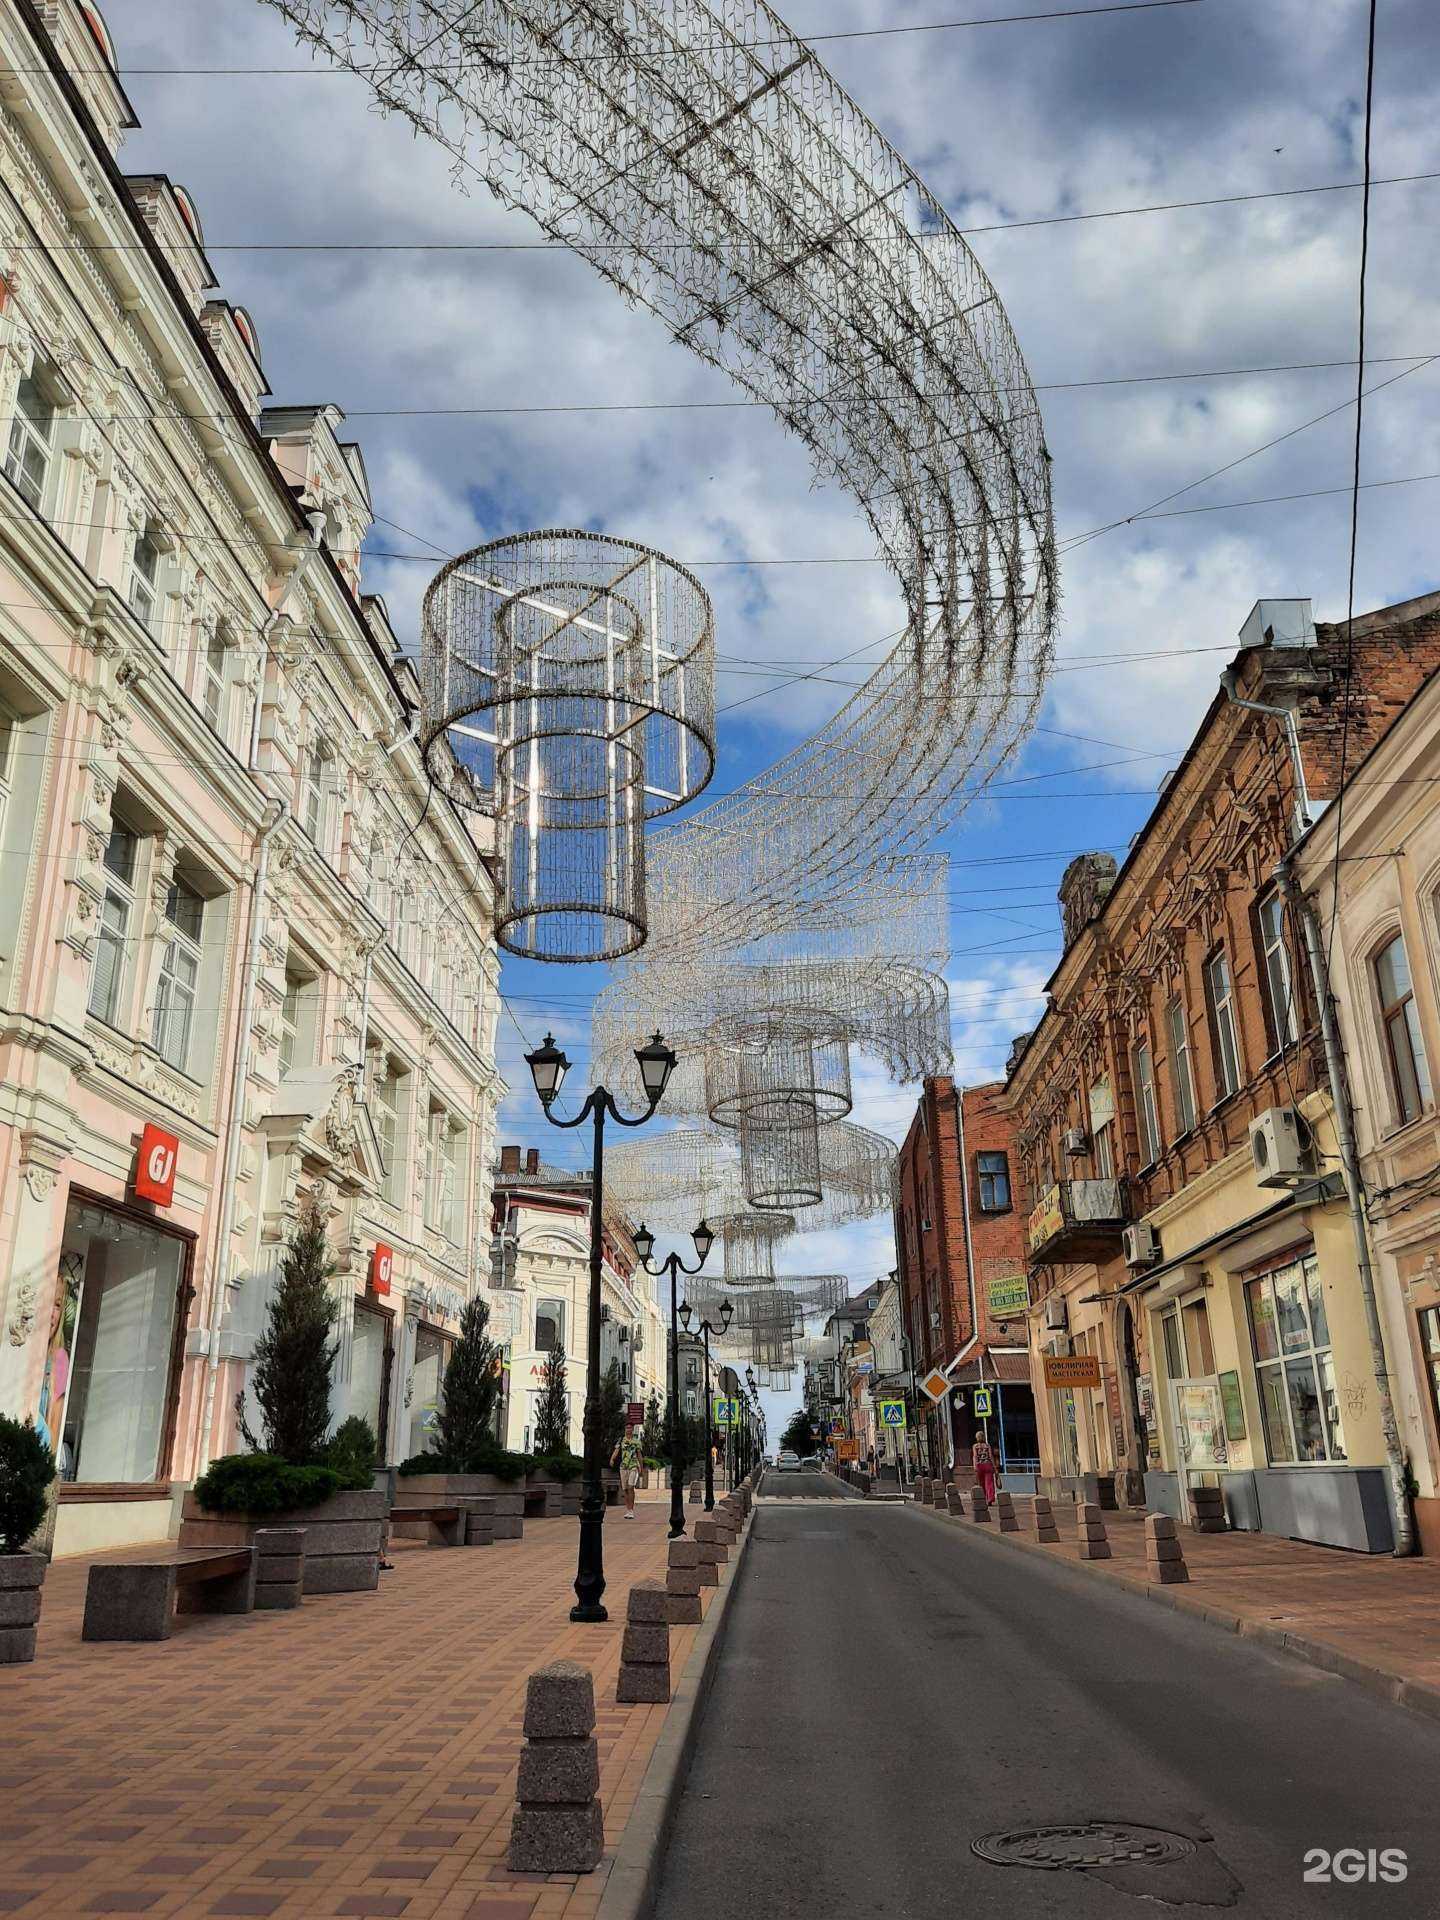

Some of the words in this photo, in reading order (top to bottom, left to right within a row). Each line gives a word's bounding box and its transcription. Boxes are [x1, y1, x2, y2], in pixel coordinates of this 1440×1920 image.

[148, 1145, 174, 1184] GJ
[379, 1256, 391, 1282] GJ
[1049, 1361, 1094, 1370] ЮВЕЛИРНАЯ
